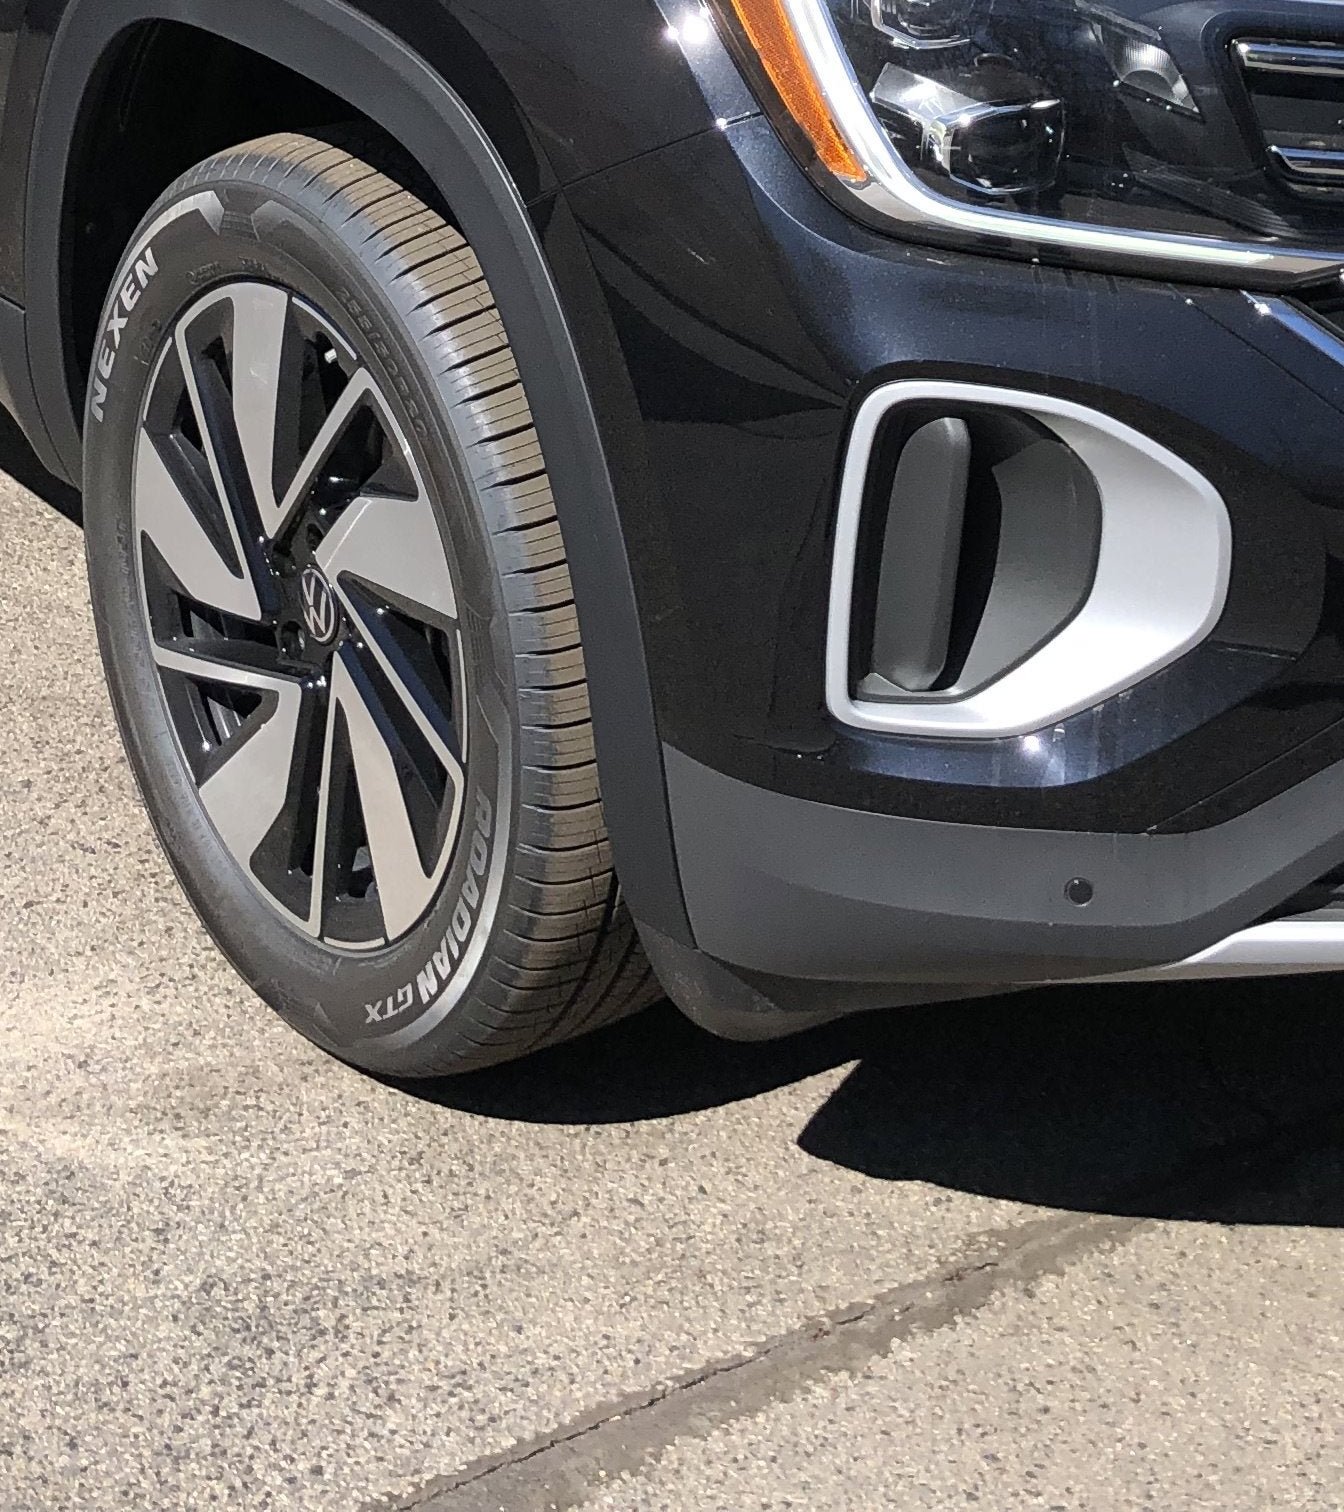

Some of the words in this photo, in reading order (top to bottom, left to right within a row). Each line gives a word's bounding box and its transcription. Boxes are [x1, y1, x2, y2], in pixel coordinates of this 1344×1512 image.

[90, 246, 159, 424] NEXEN
[415, 786, 493, 1005] ROADIAN
[364, 982, 414, 1025] GTX
